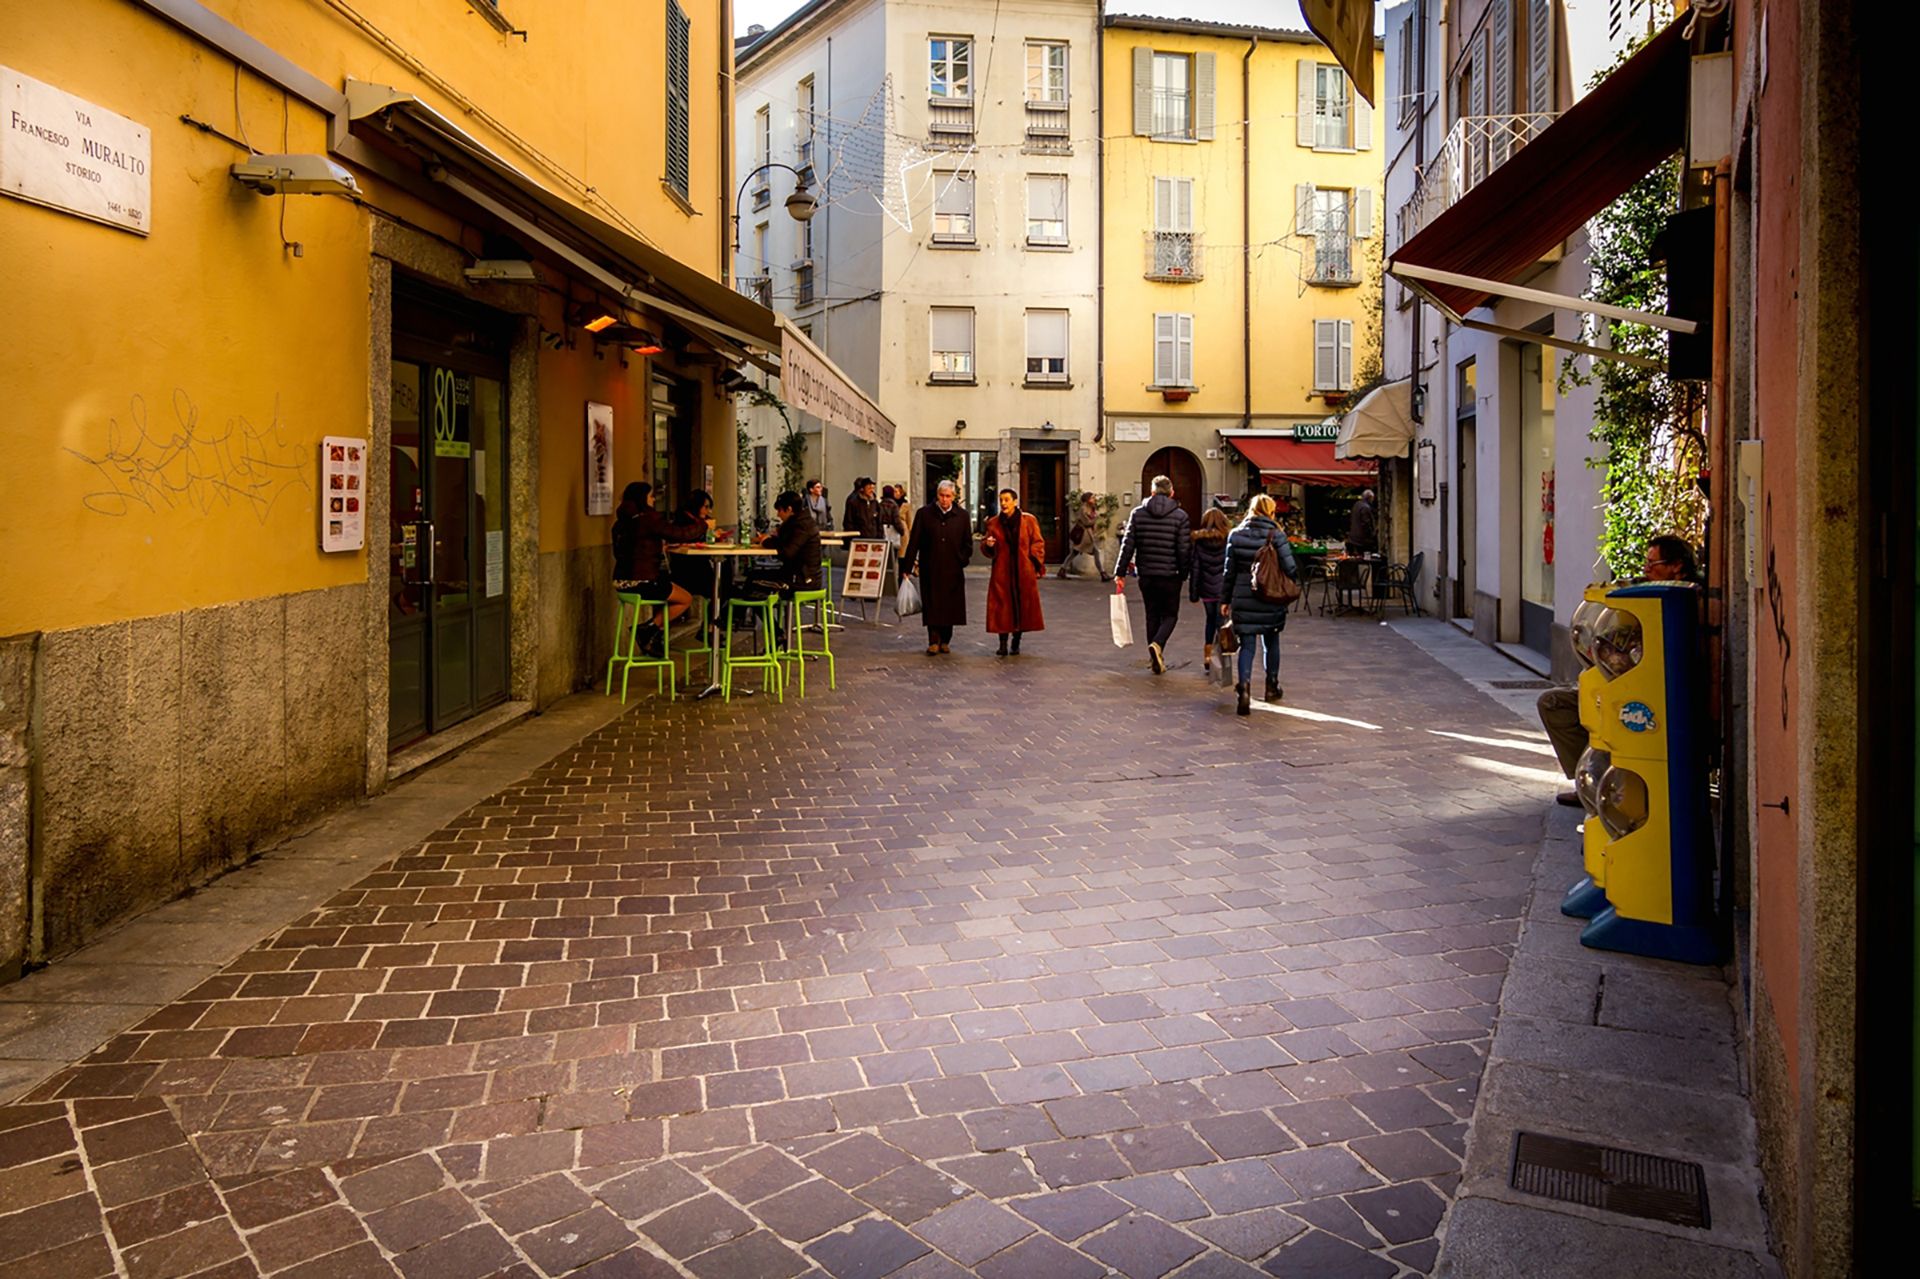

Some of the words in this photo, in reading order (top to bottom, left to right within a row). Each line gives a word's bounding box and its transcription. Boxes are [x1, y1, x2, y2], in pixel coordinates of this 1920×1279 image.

[75, 110, 92, 127] VIA
[11, 110, 70, 148] FRANCESCO
[81, 138, 145, 176] MURALTO
[65, 162, 102, 183] STORICO
[435, 367, 456, 442] 80
